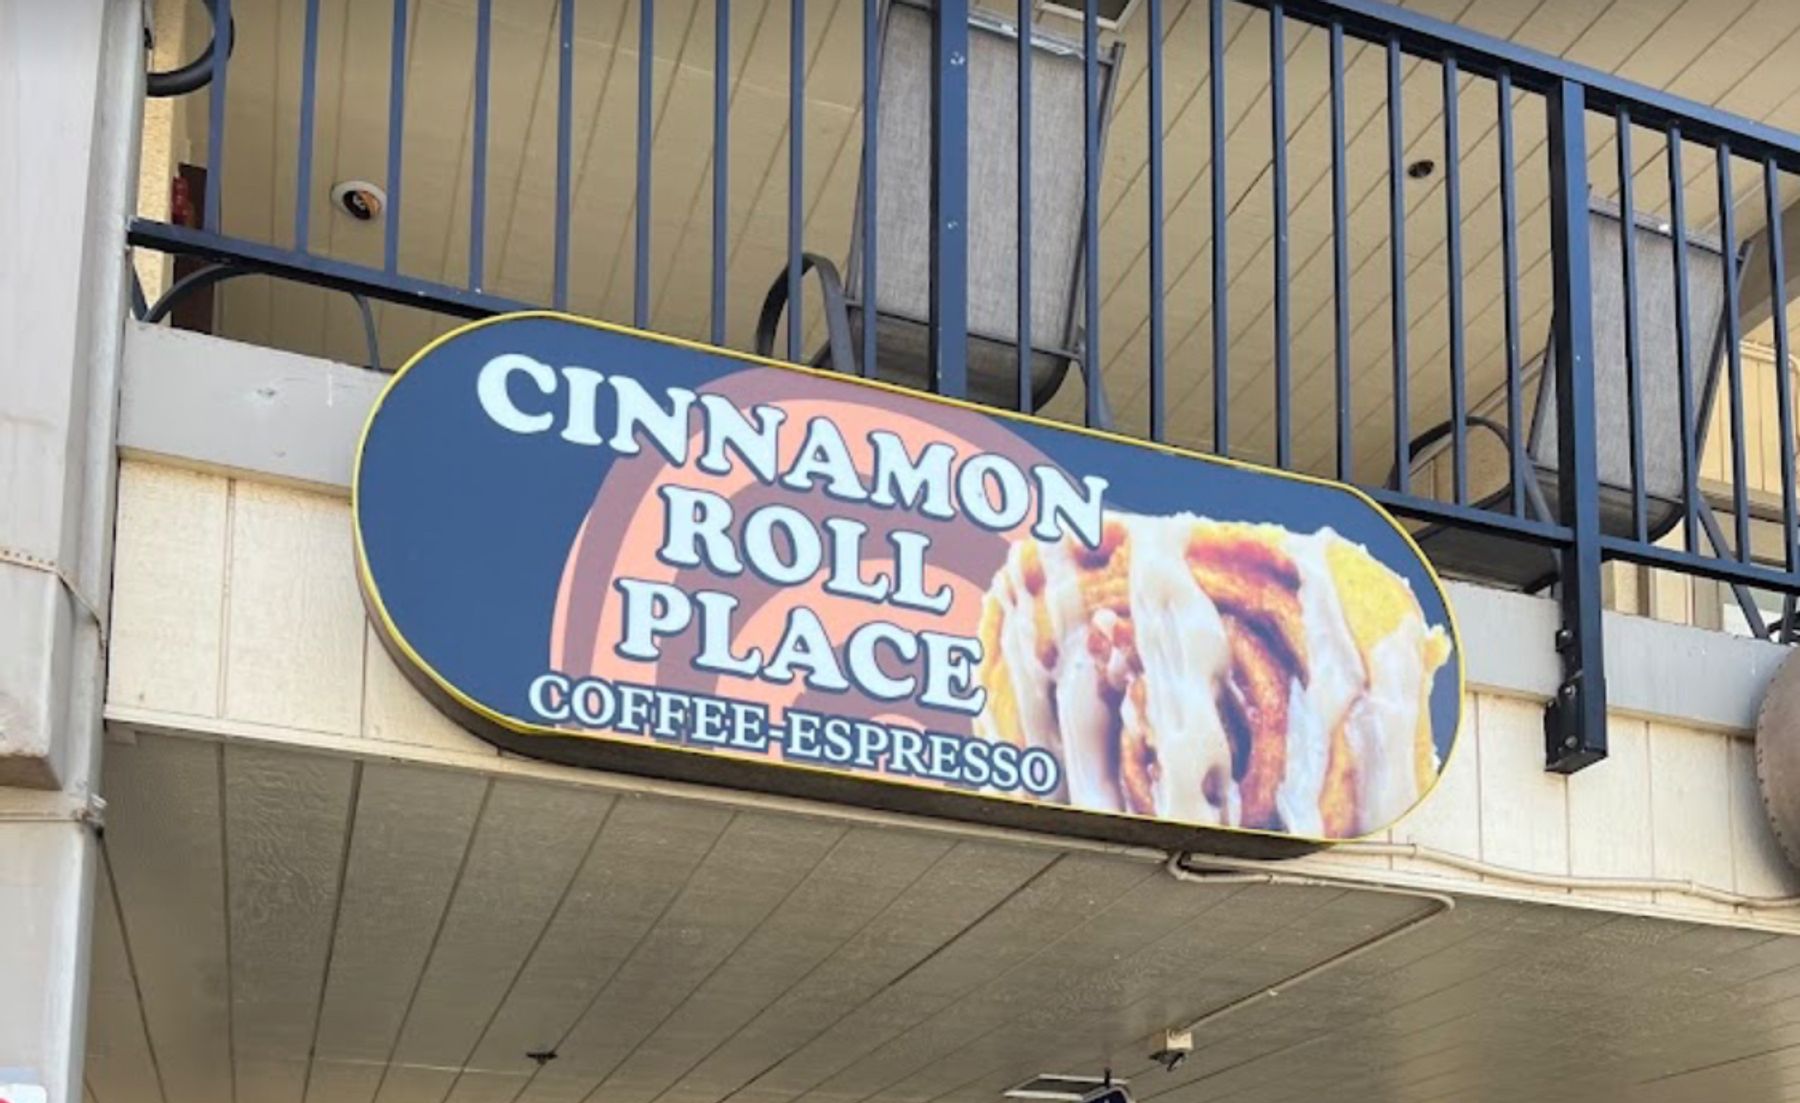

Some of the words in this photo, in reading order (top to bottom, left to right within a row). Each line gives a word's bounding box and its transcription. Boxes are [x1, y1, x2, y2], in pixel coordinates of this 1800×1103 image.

[476, 352, 1110, 548] CINNAMON
[660, 484, 956, 616] ROLL
[615, 577, 986, 717] PLACE
[528, 674, 1060, 797] COFFEE-ESPRESSO
